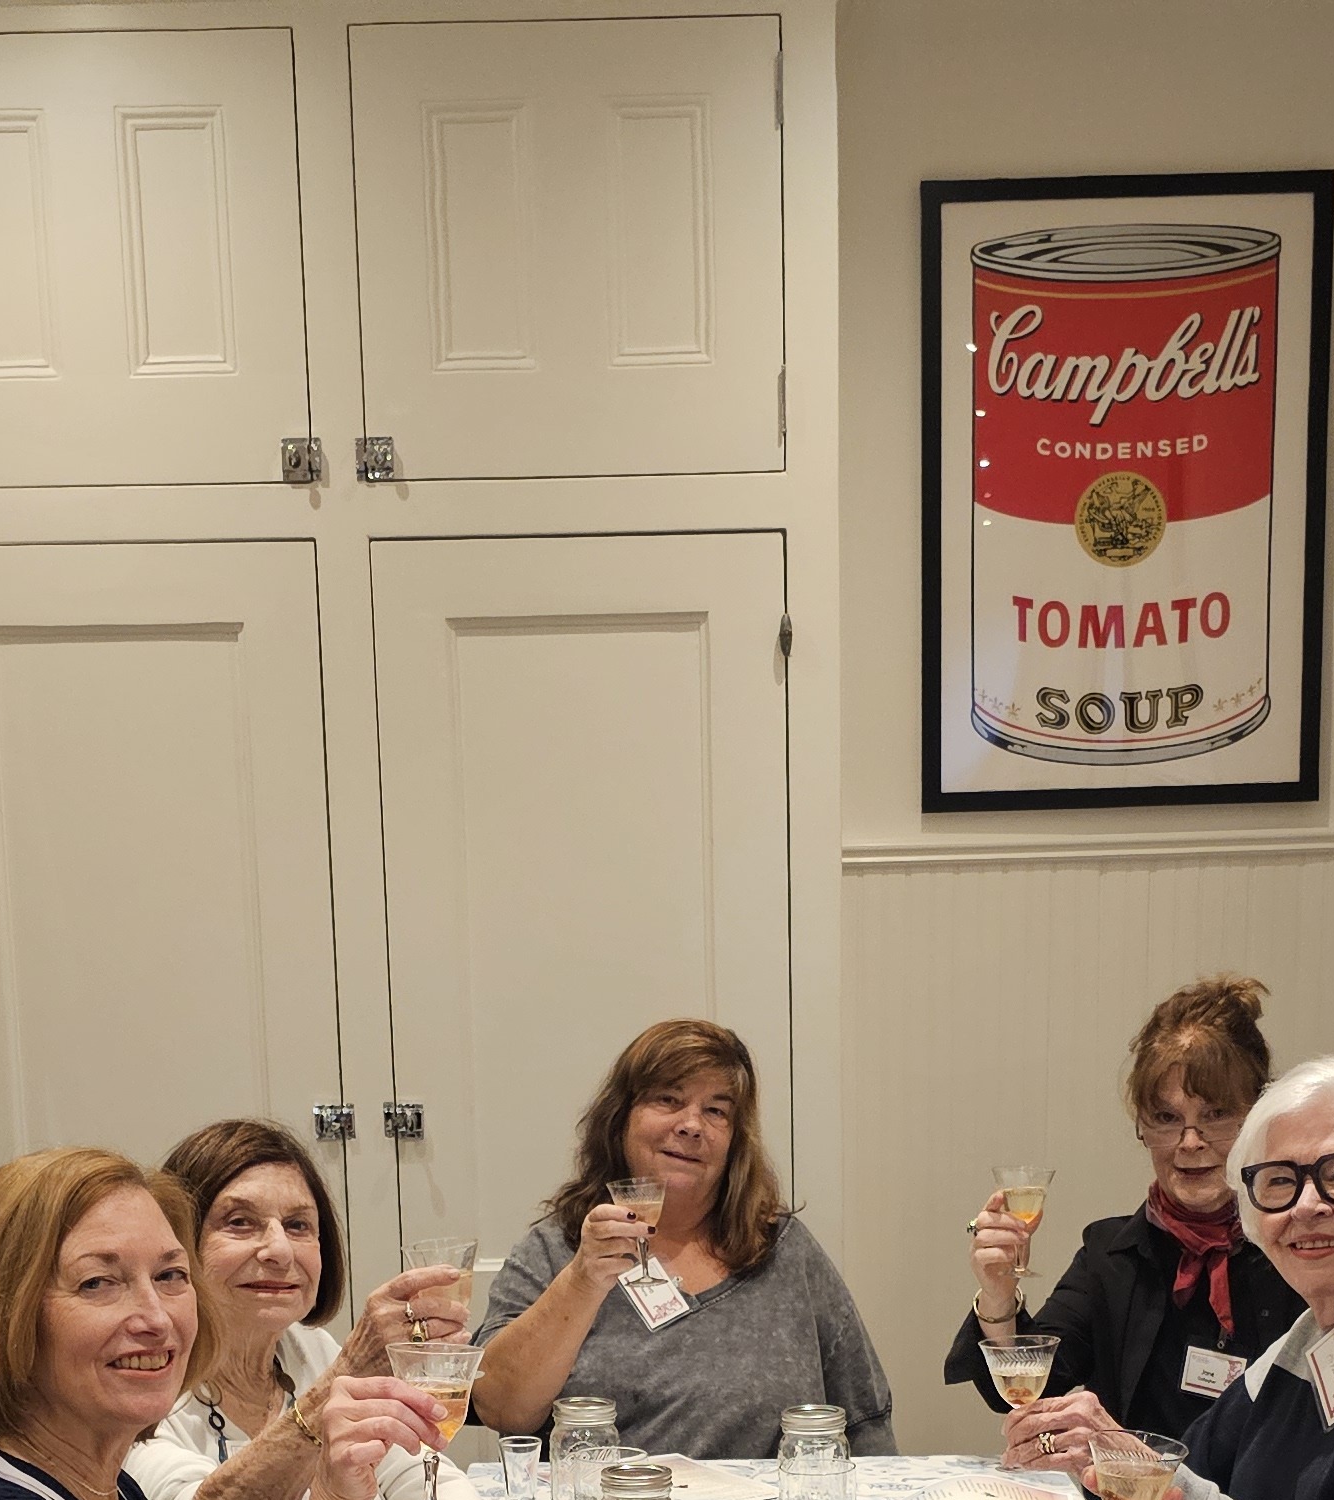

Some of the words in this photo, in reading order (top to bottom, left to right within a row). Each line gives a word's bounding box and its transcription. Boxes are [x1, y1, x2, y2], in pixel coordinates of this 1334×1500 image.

[988, 304, 1263, 426] Campbell's
[1036, 434, 1209, 459] CONDENSED
[1012, 592, 1231, 649] TOMATO
[1036, 684, 1204, 734] SOUP
